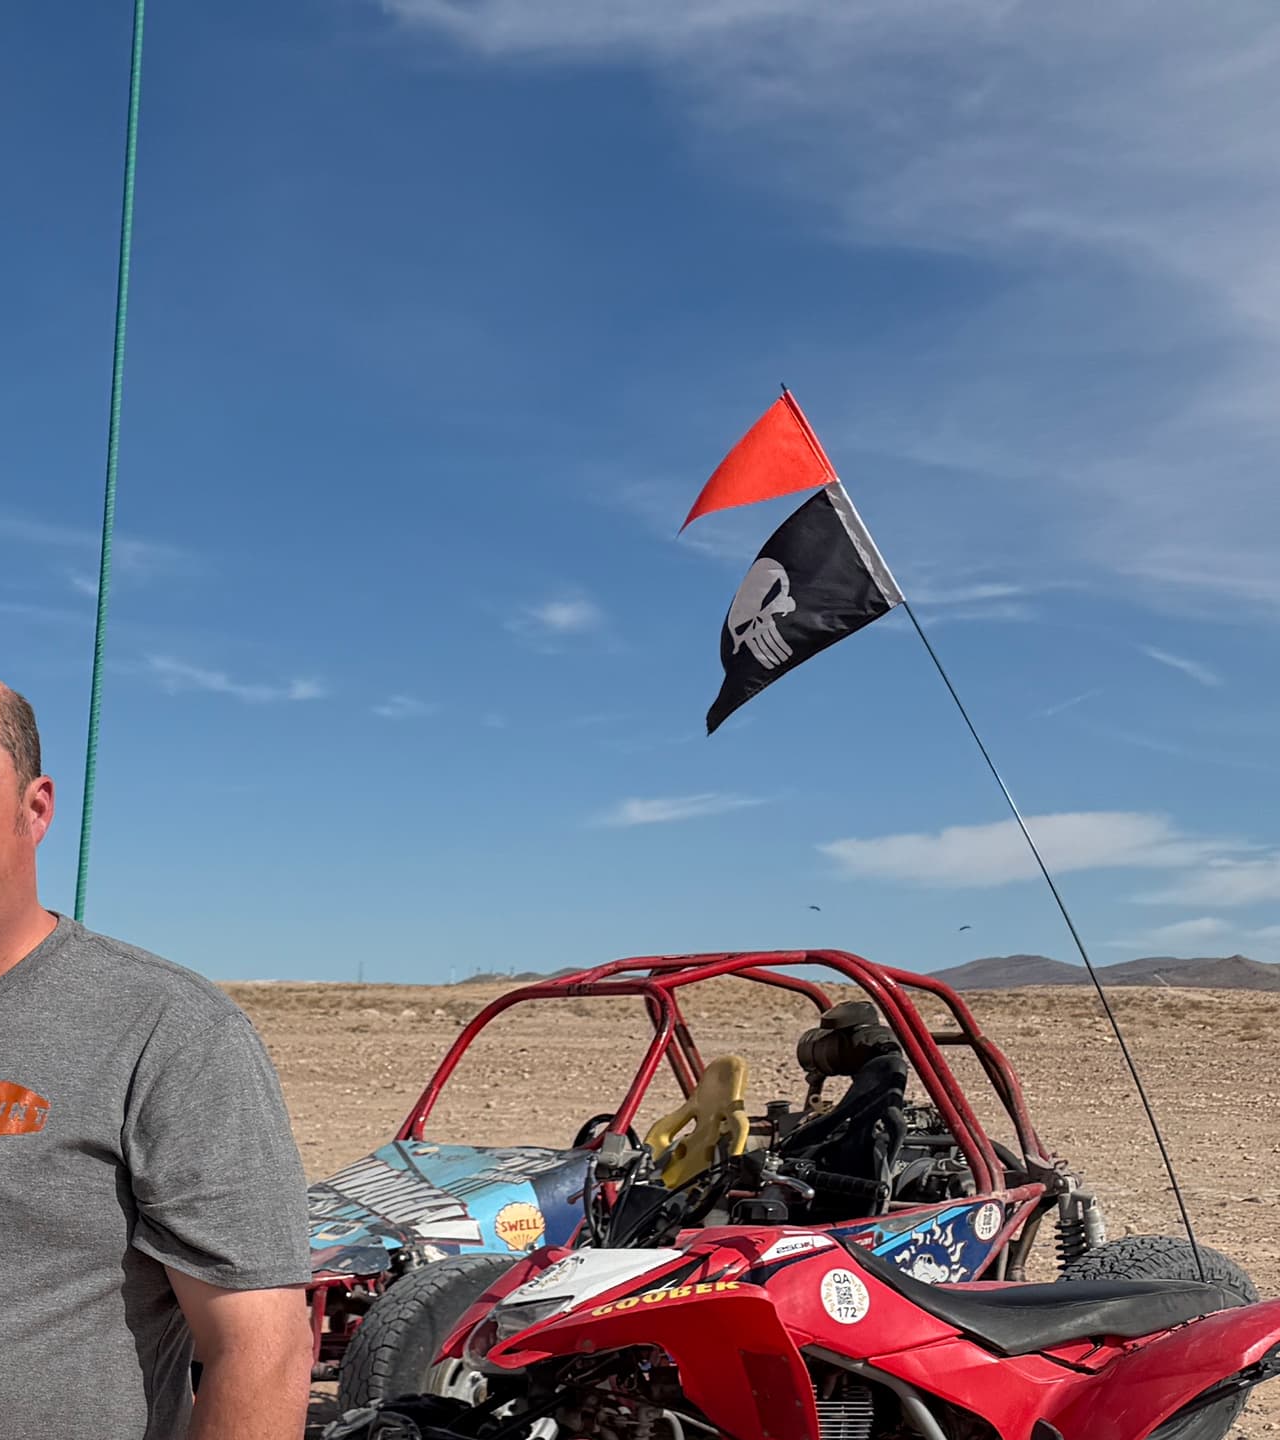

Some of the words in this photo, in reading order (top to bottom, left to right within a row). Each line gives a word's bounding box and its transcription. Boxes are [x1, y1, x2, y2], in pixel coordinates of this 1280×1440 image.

[500, 1218, 540, 1232] SWELL
[832, 1273, 851, 1284] QA
[837, 1306, 858, 1318] 172
